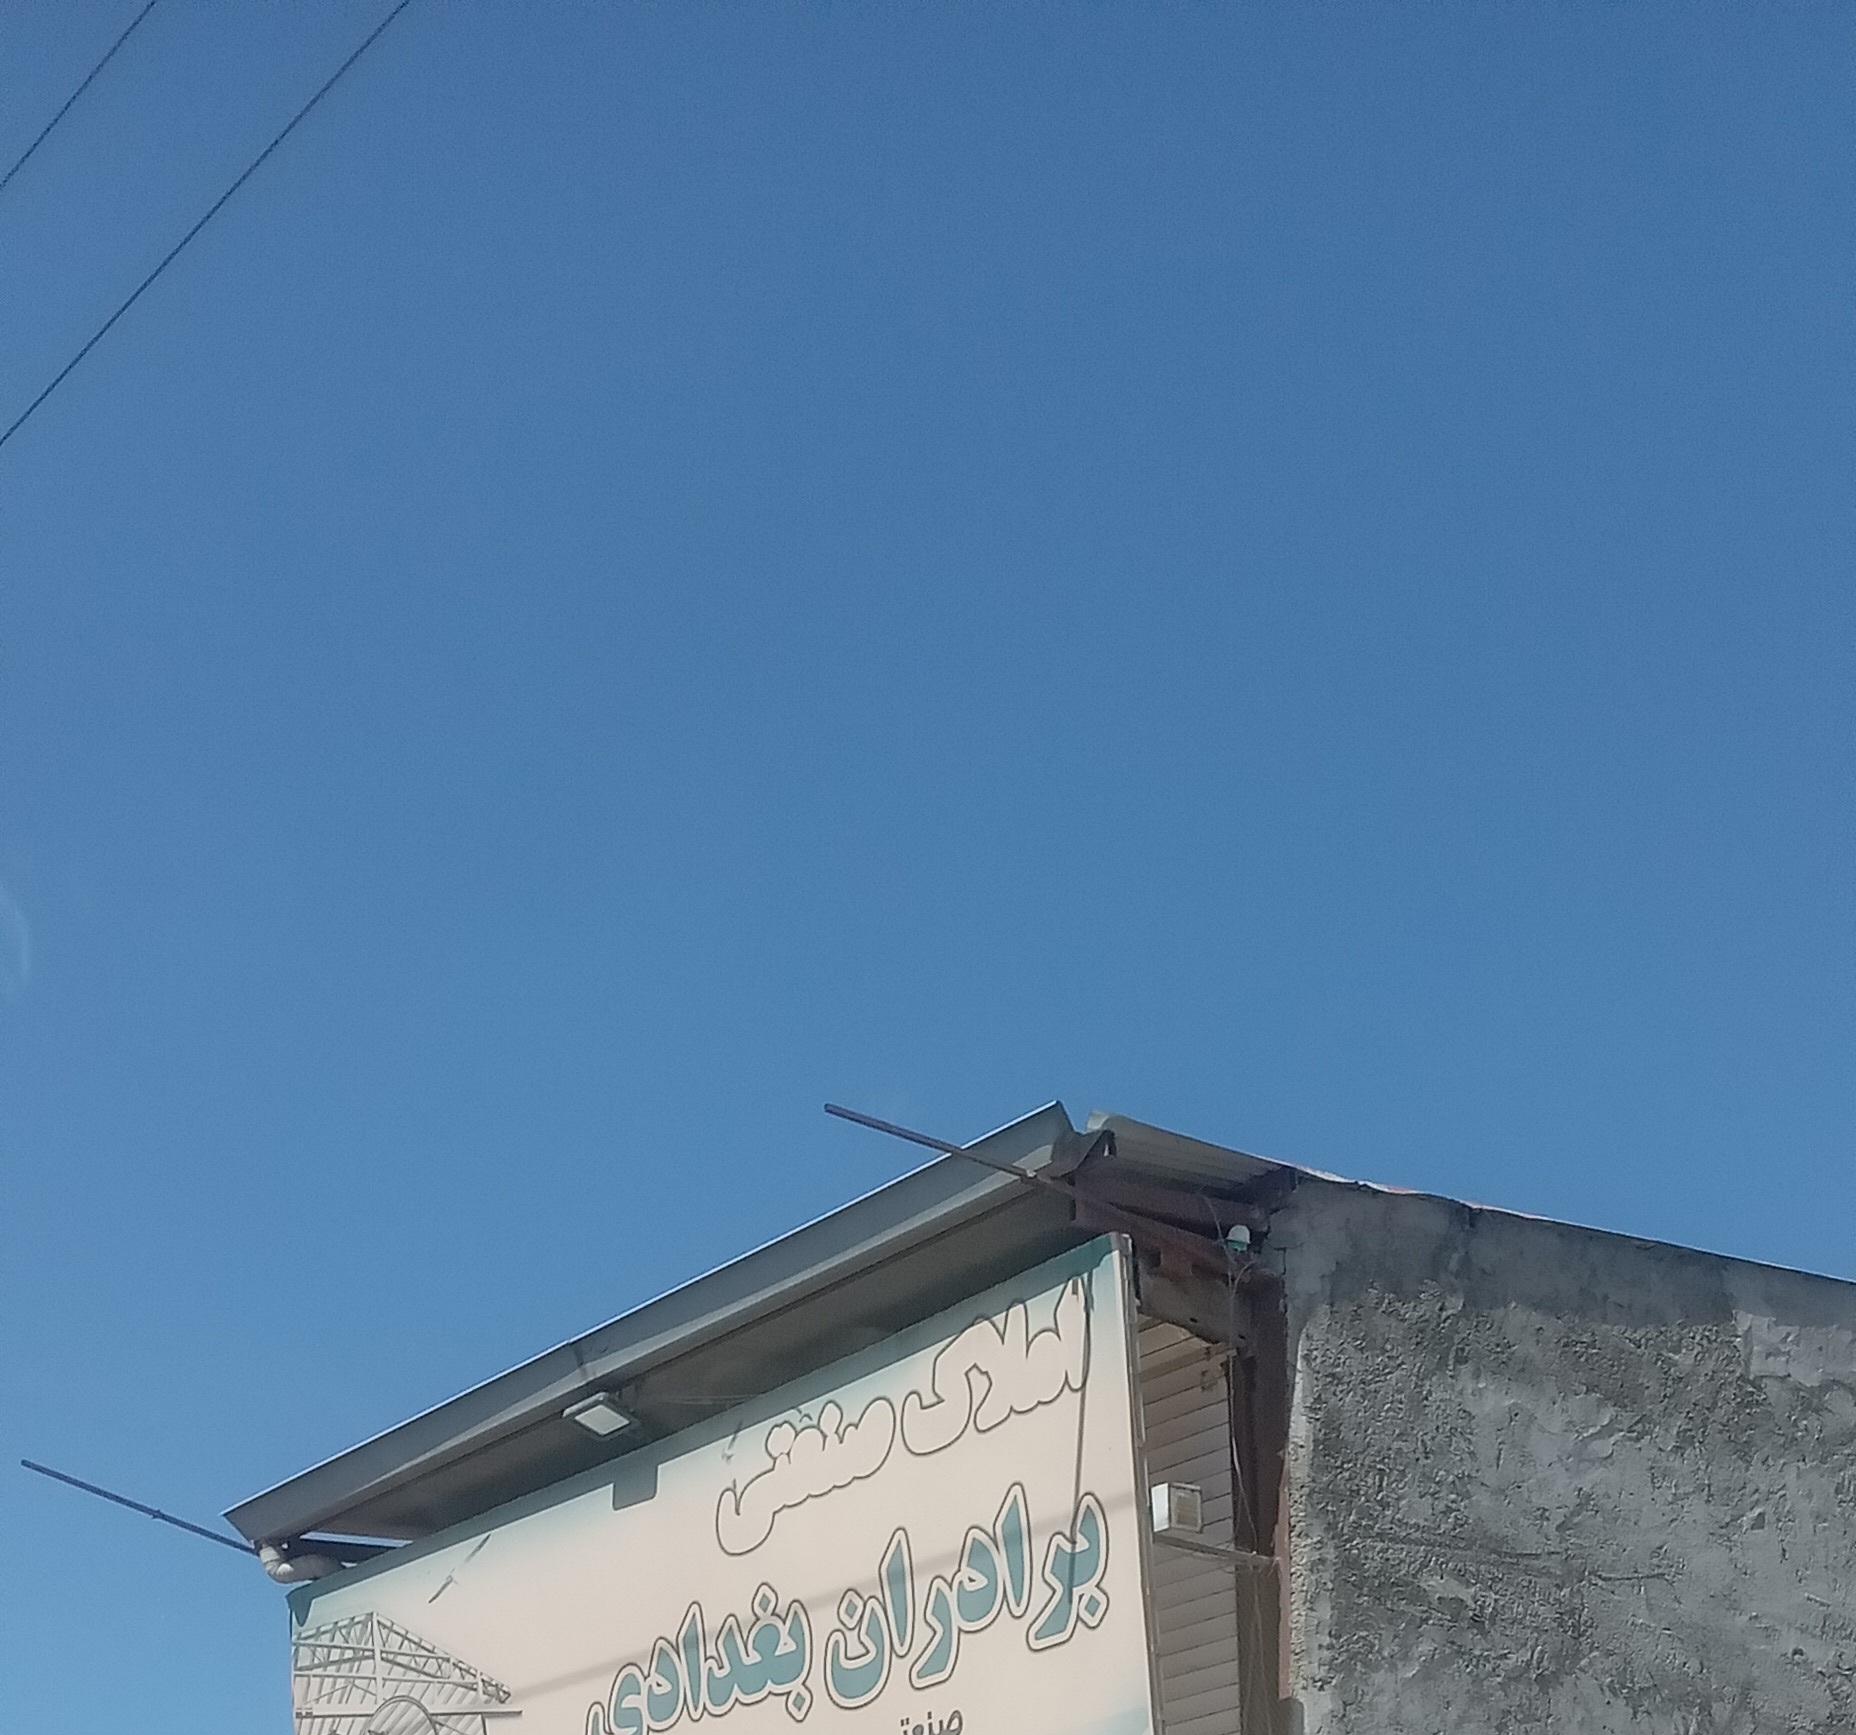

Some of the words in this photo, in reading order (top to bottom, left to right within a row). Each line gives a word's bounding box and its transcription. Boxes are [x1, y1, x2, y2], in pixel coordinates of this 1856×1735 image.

[901, 1276, 1090, 1456] املاک
[716, 1397, 896, 1556] صنعتی
[824, 1482, 1108, 1710] برادران
